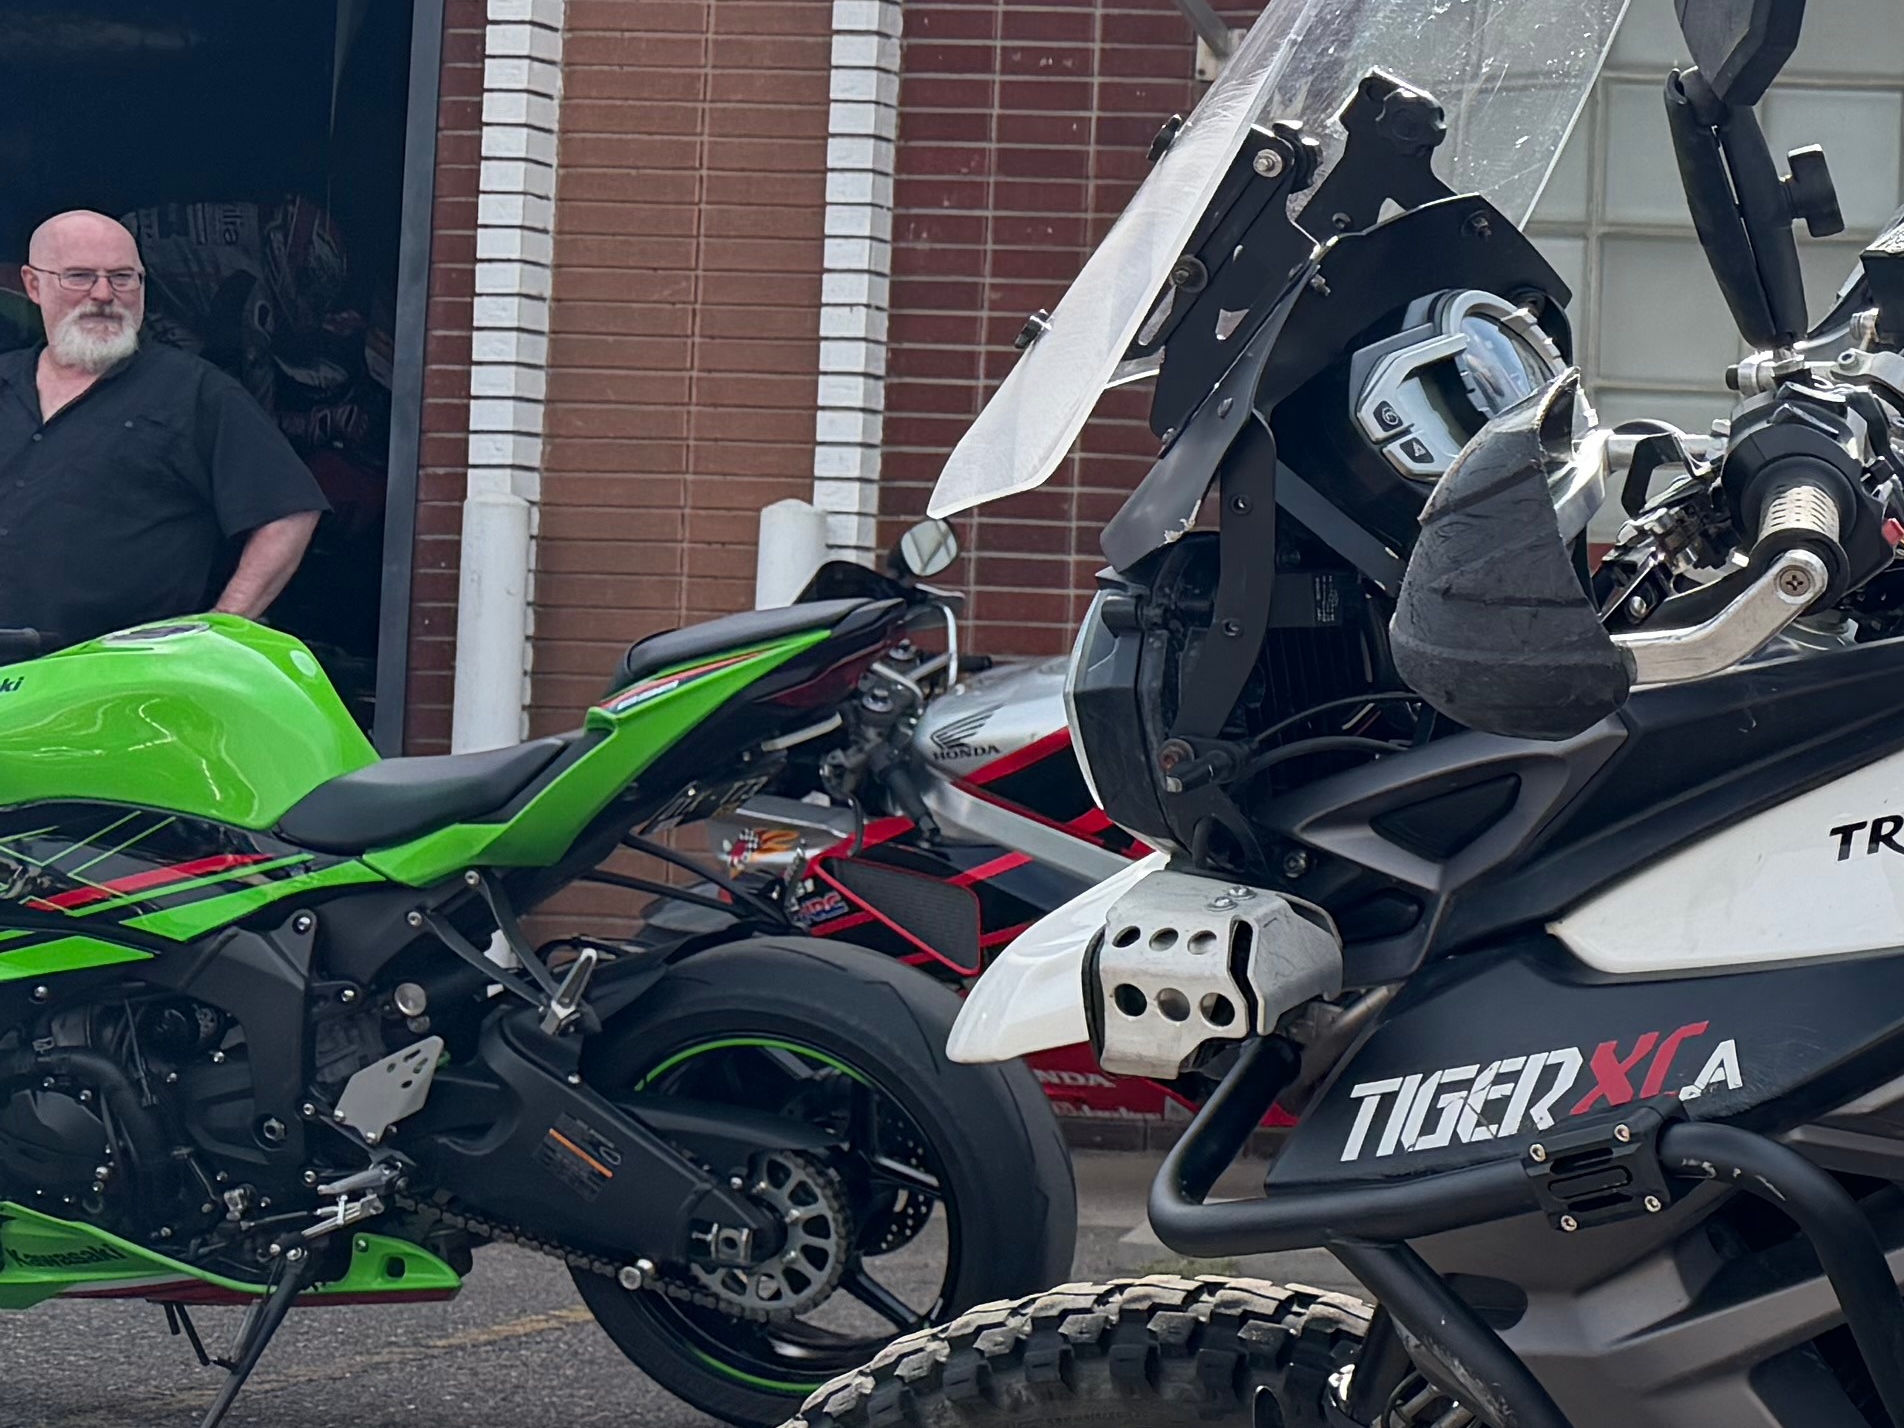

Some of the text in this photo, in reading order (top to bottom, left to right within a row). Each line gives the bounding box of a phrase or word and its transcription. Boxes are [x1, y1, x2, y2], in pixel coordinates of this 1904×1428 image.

[932, 744, 1001, 761] HONDA
[1340, 1046, 1584, 1162] TIGER
[5, 1242, 128, 1267] Kawasaki
